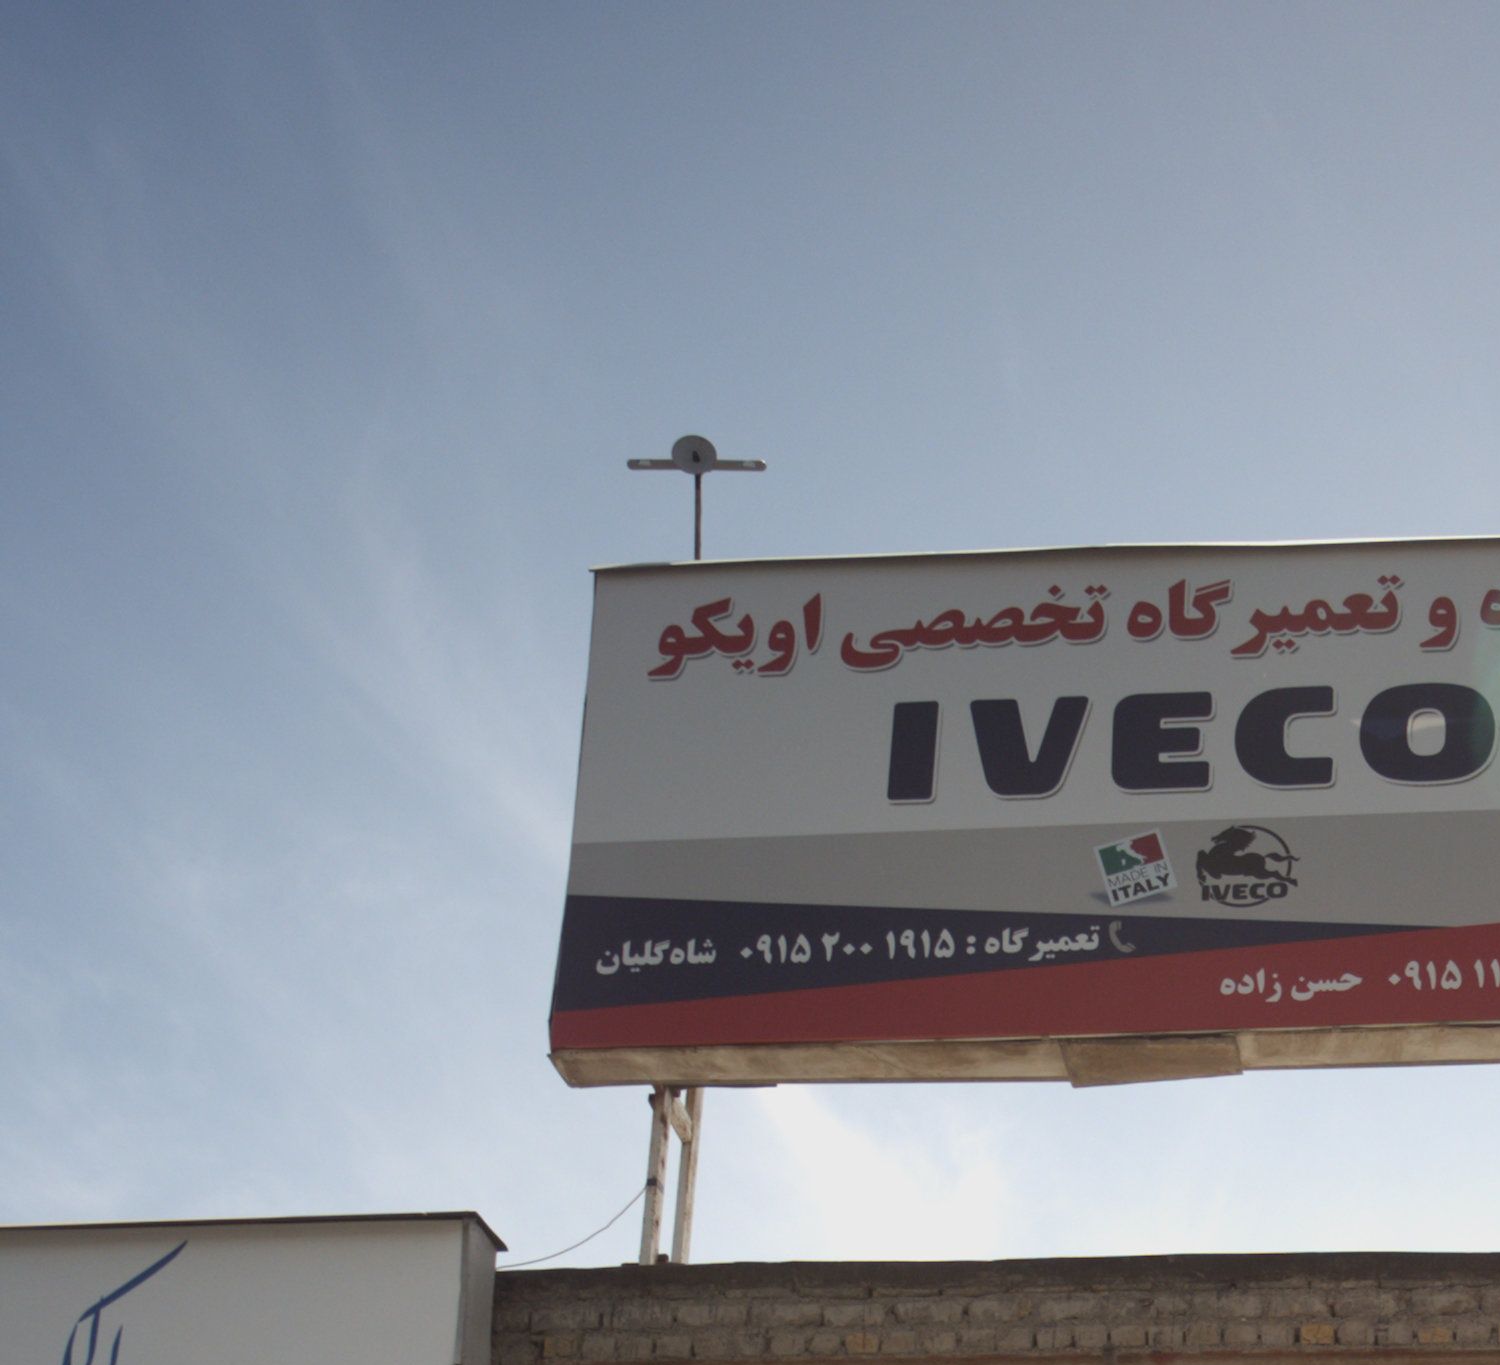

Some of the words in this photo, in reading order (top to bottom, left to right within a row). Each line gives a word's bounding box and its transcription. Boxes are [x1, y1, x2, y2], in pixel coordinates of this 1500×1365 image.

[647, 593, 824, 679] اویکو
[841, 585, 1111, 672] تخصصی
[1419, 602, 1459, 651] و
[887, 682, 1497, 803] IVECO
[1108, 868, 1149, 888] MADE
[1154, 863, 1168, 873] IN
[1111, 873, 1170, 901] ITALY
[1201, 881, 1288, 901] IVECO
[740, 933, 811, 964] ۰۹۱۵
[821, 931, 873, 960] ۲۰۰
[885, 928, 955, 960] ۱۹۱۵
[1220, 966, 1284, 1003] زاده
[1292, 969, 1362, 1001] حسن
[1387, 958, 1461, 991] ۰۹۱۵
